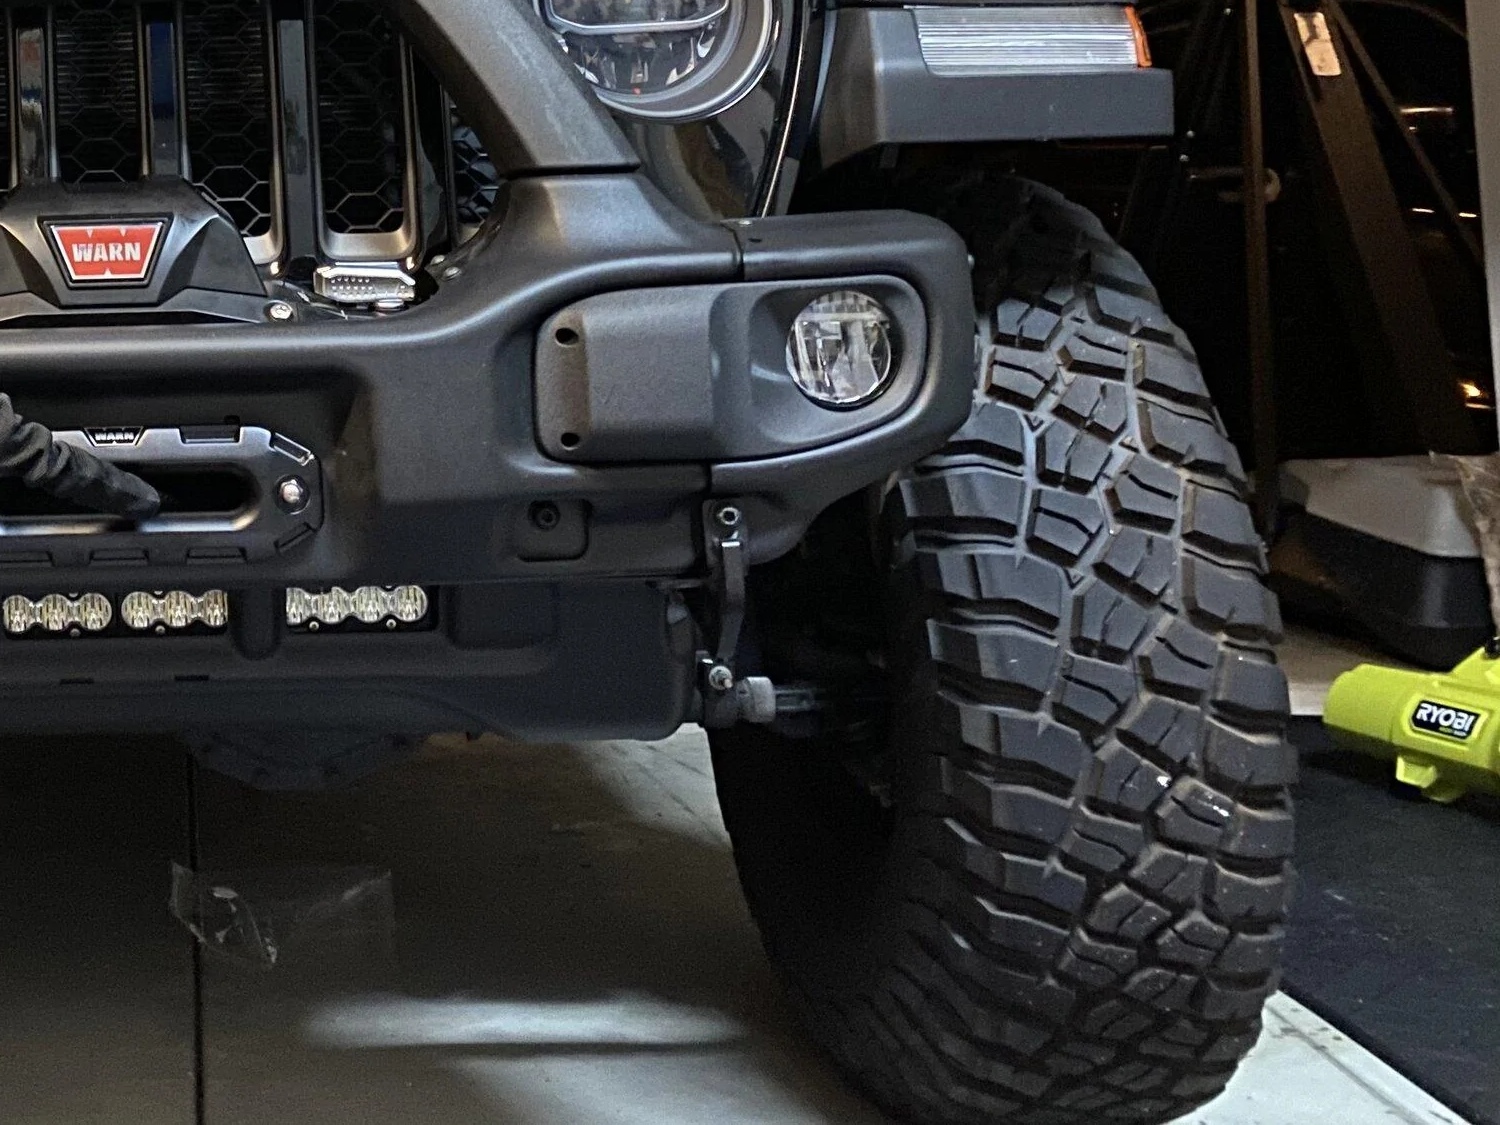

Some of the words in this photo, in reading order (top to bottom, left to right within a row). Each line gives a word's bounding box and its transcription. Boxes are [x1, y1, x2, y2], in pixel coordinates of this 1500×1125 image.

[71, 242, 141, 263] WARN
[94, 431, 134, 441] WARN
[1416, 703, 1475, 732] RYOBI
